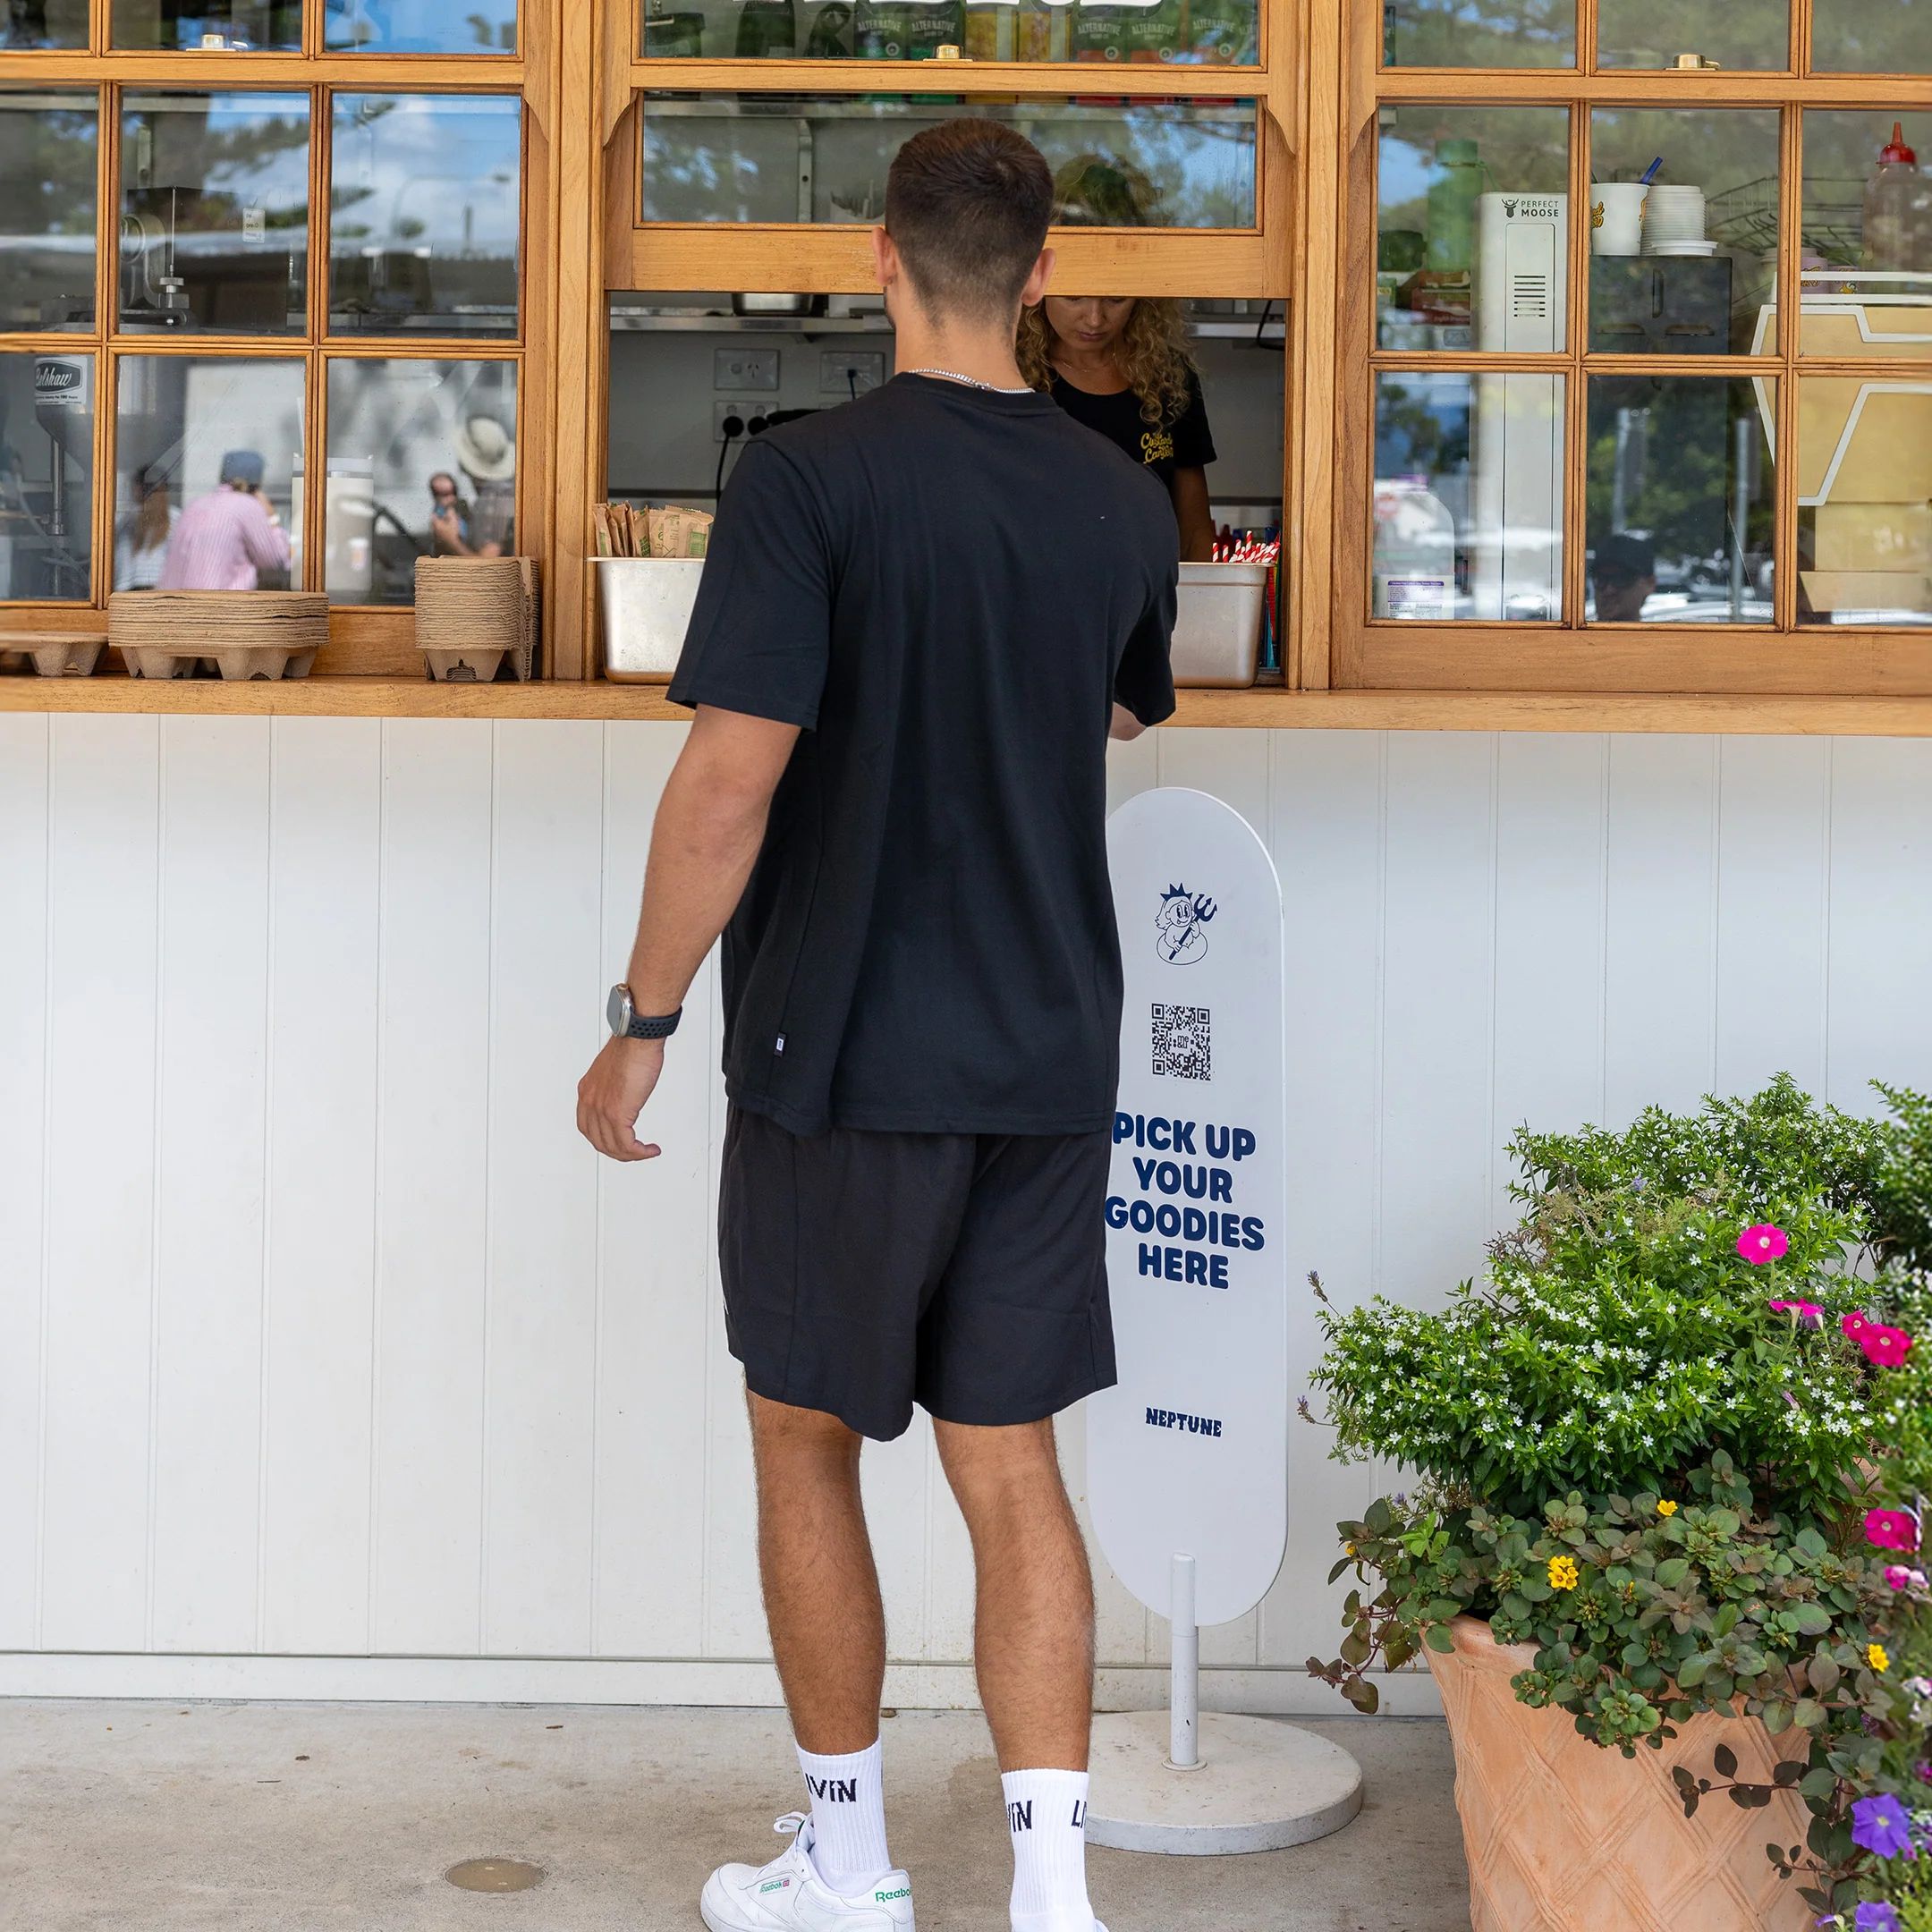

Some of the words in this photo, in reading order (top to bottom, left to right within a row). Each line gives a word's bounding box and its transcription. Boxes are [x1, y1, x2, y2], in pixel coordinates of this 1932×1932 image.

[857, 19, 902, 32] ALTERNATIVE
[911, 20, 956, 32] ALTERNATIVE
[1077, 21, 1122, 36] ALTERNATIVE
[1131, 22, 1176, 37] ALTERNATIVE
[1521, 208, 1559, 217] MOOSE
[1112, 1111, 1197, 1156] PICK
[1205, 1123, 1256, 1162] UP
[1132, 1157, 1233, 1204] YOUR
[1104, 1195, 1265, 1251] GOODIES
[1138, 1242, 1229, 1290] HERE
[1145, 1407, 1222, 1437] NEPTUNE
[759, 1881, 783, 1894] Reebok
